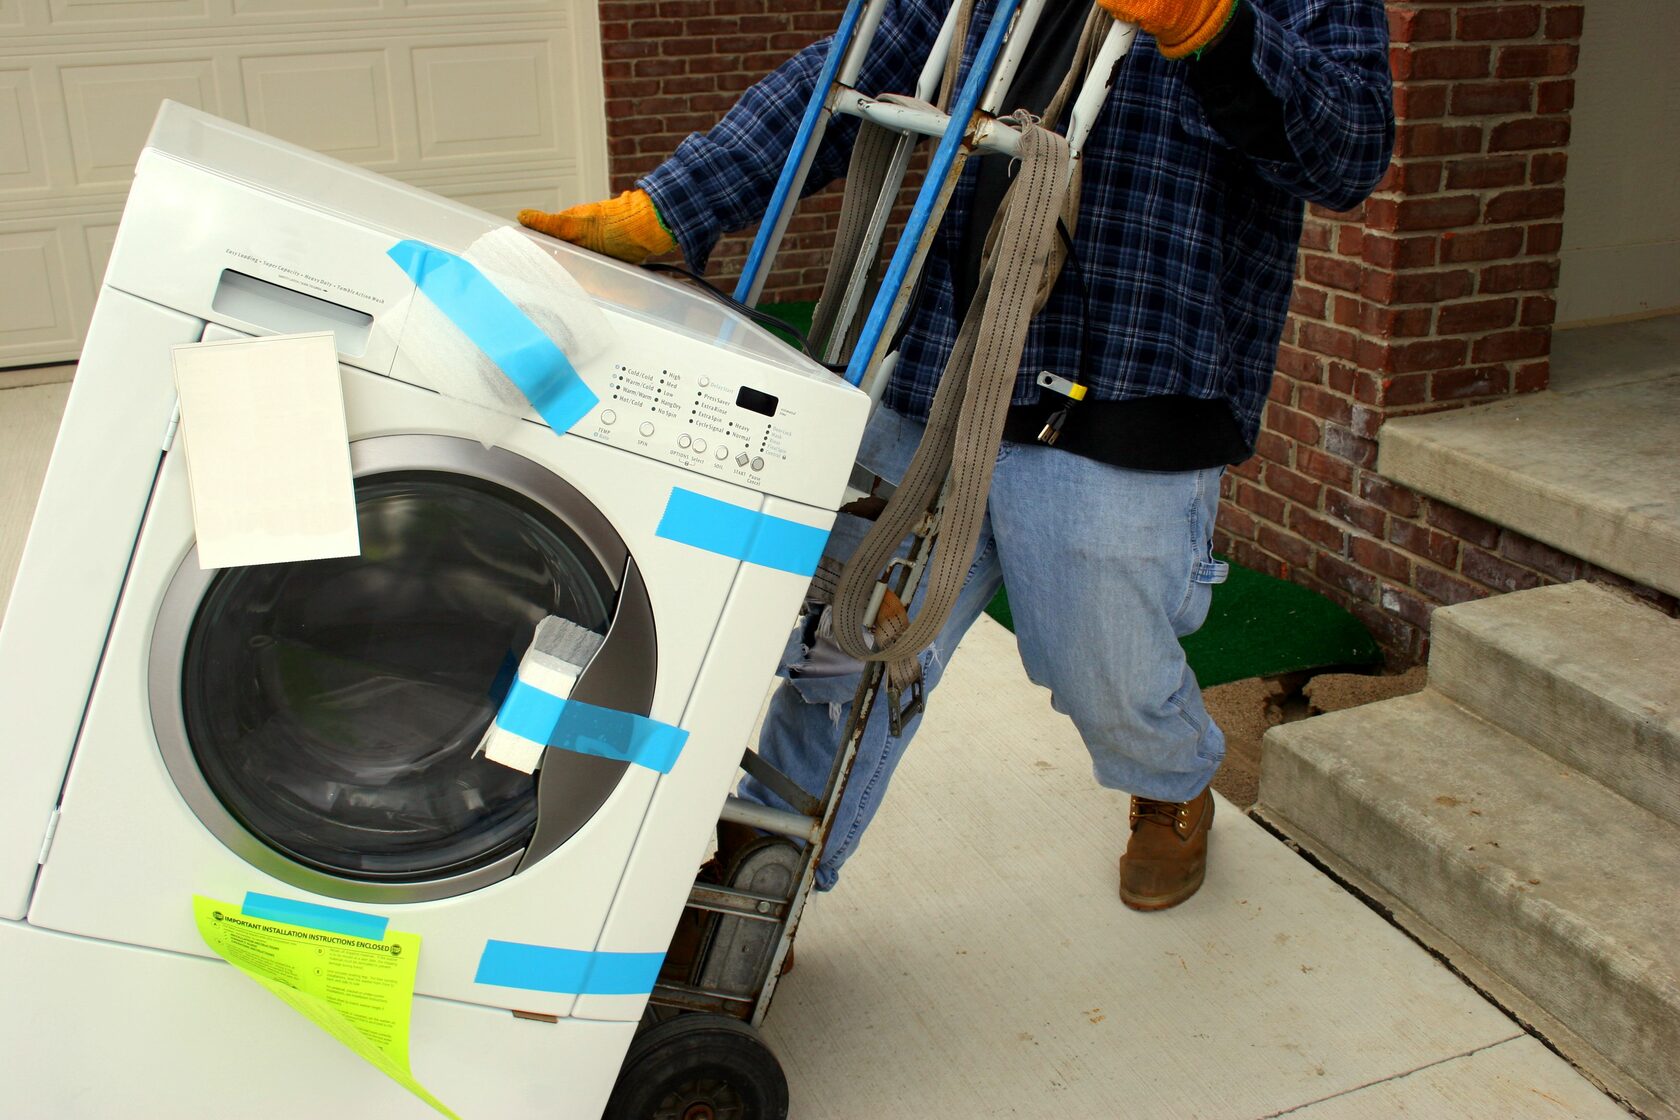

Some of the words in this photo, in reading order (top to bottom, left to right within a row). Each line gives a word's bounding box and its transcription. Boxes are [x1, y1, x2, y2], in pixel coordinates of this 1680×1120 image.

[225, 916, 262, 930] IMPORTANT
[262, 925, 308, 939] INSTALLATION
[308, 934, 356, 947] INSTRUCTIONS
[356, 941, 390, 952] ENCLOSED
